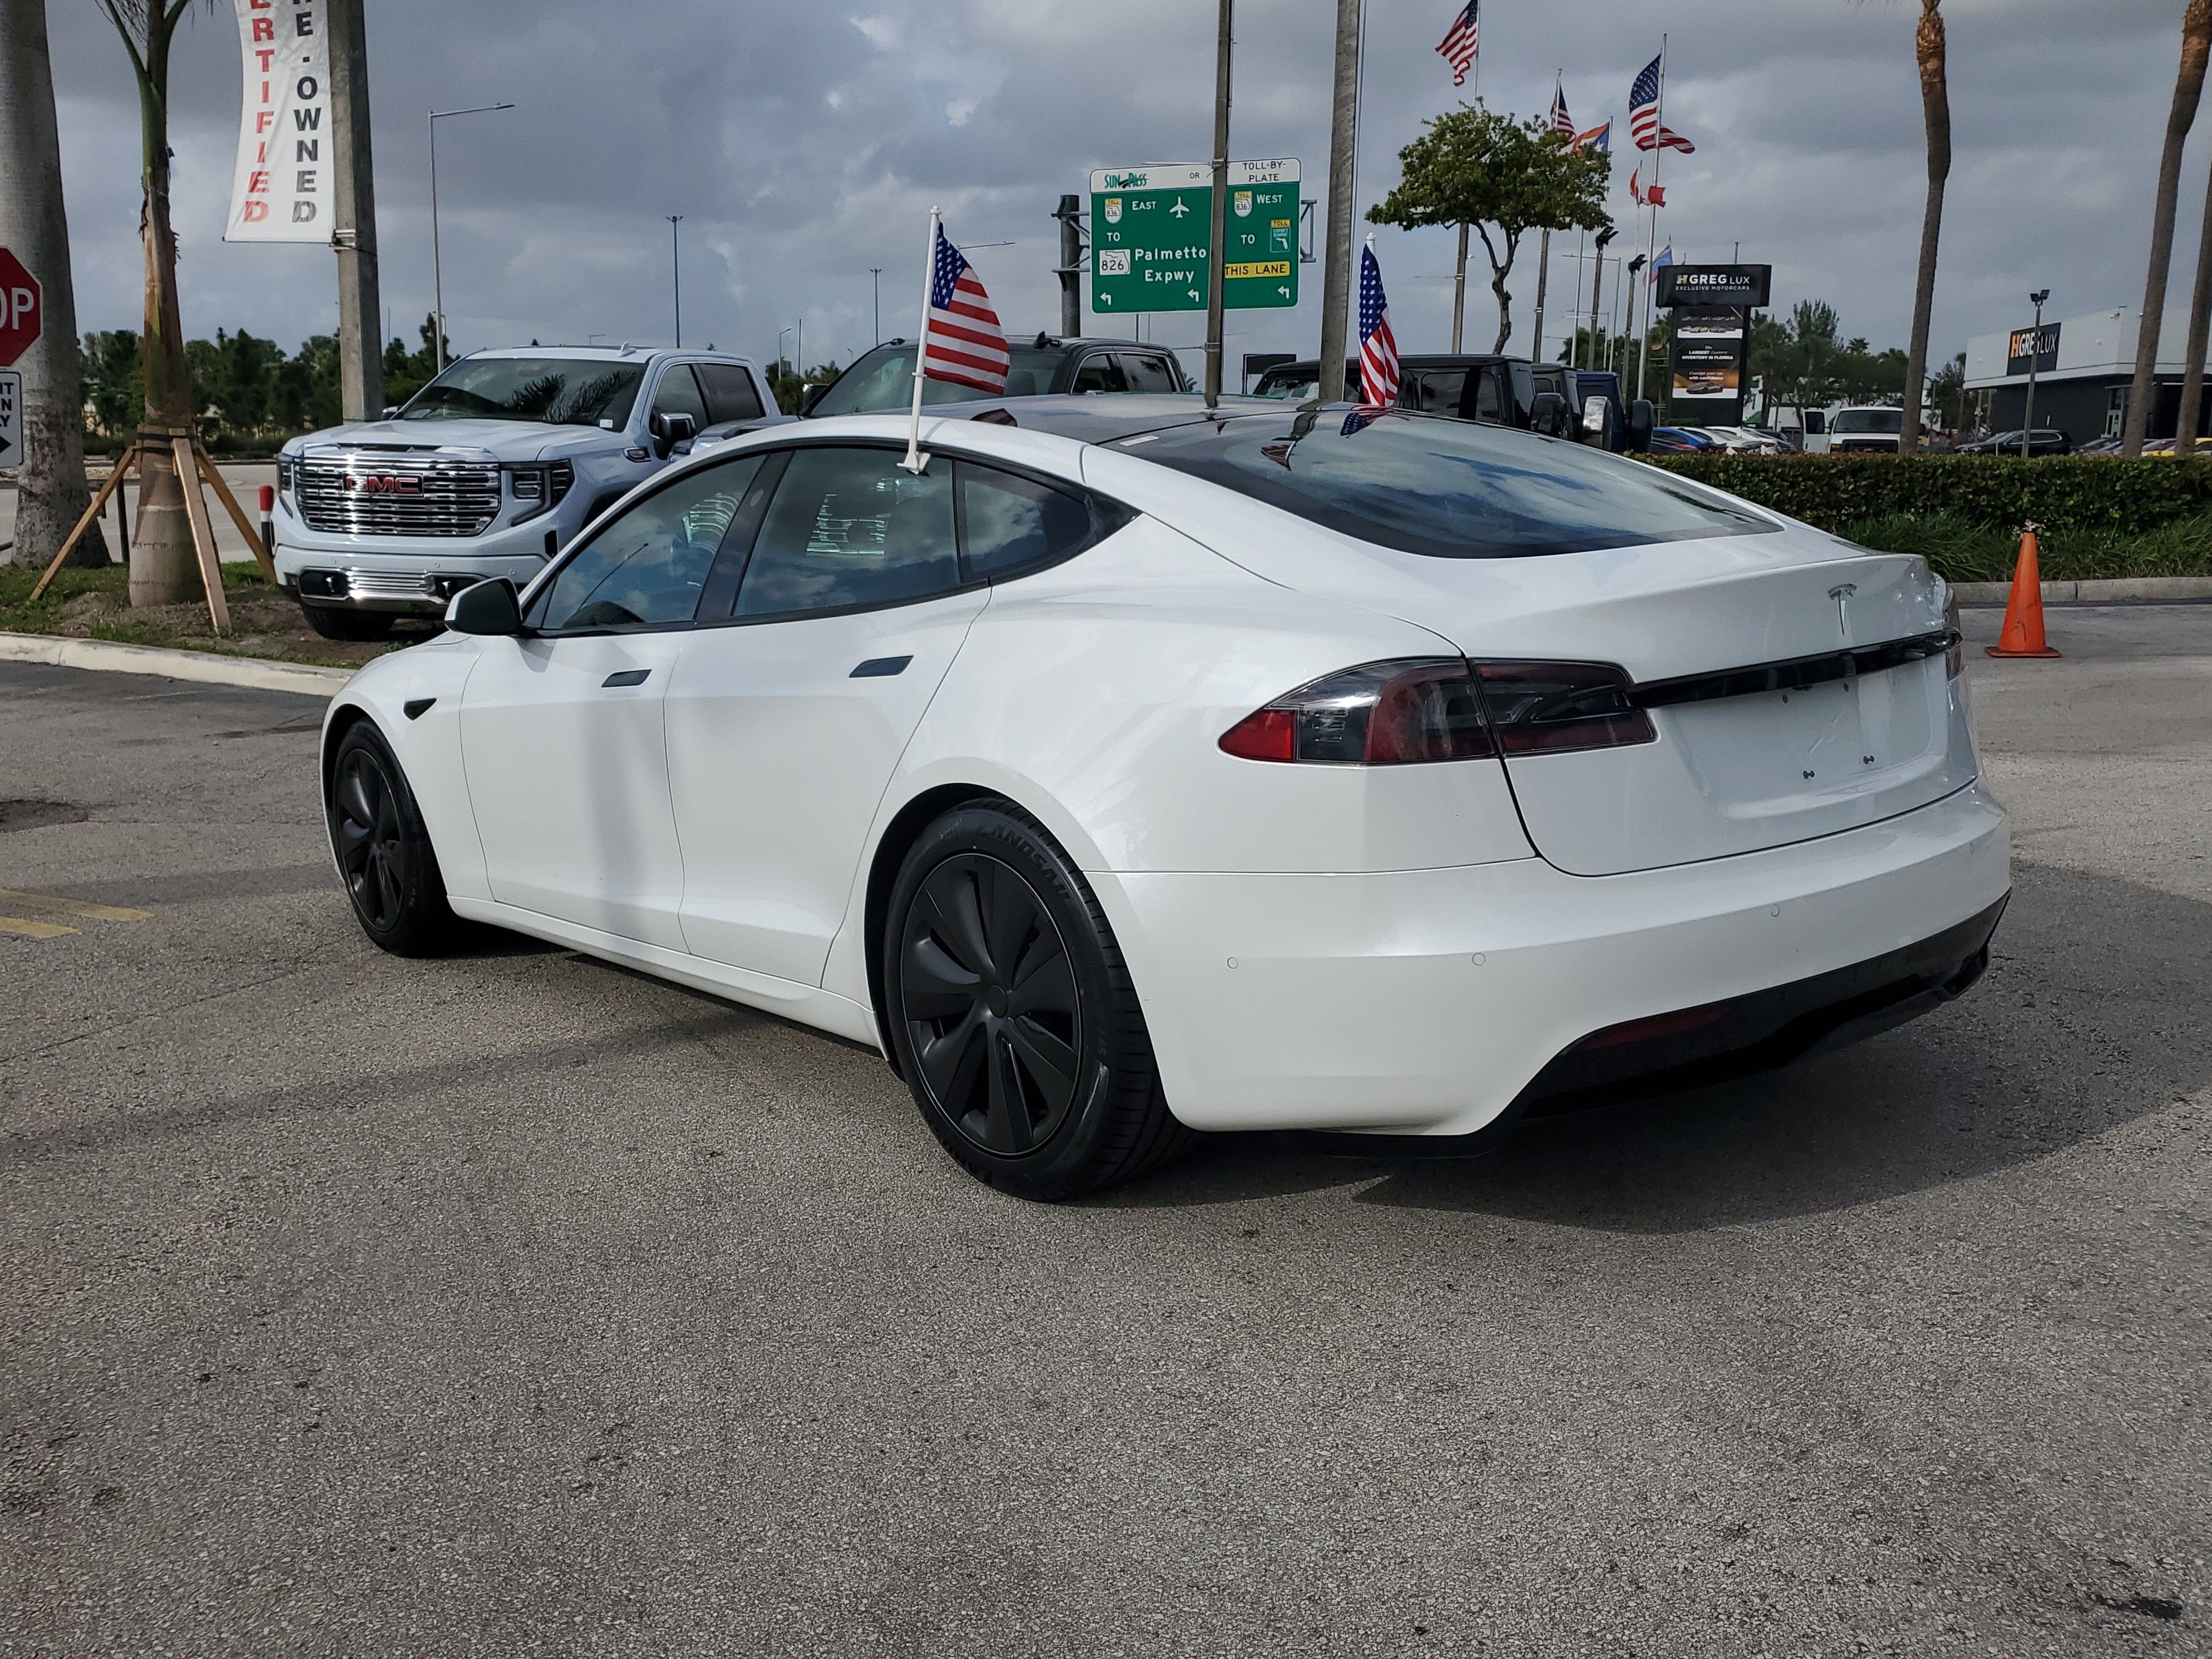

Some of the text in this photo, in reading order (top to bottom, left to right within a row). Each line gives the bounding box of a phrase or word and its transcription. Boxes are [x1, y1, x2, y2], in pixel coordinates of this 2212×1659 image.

[1243, 161, 1286, 171] TOLL-BY-
[1249, 173, 1279, 183] PLATE
[1256, 194, 1283, 205] WEST
[1132, 201, 1157, 211] EAST
[1107, 232, 1121, 242] TO
[1240, 234, 1255, 245] TO
[1135, 246, 1207, 261] Palmetto
[1101, 259, 1125, 271] 826
[1224, 264, 1286, 276] THIS LANE
[1145, 269, 1195, 284] Expwy
[1729, 276, 1750, 285] LUX
[346, 475, 421, 493] GMC
